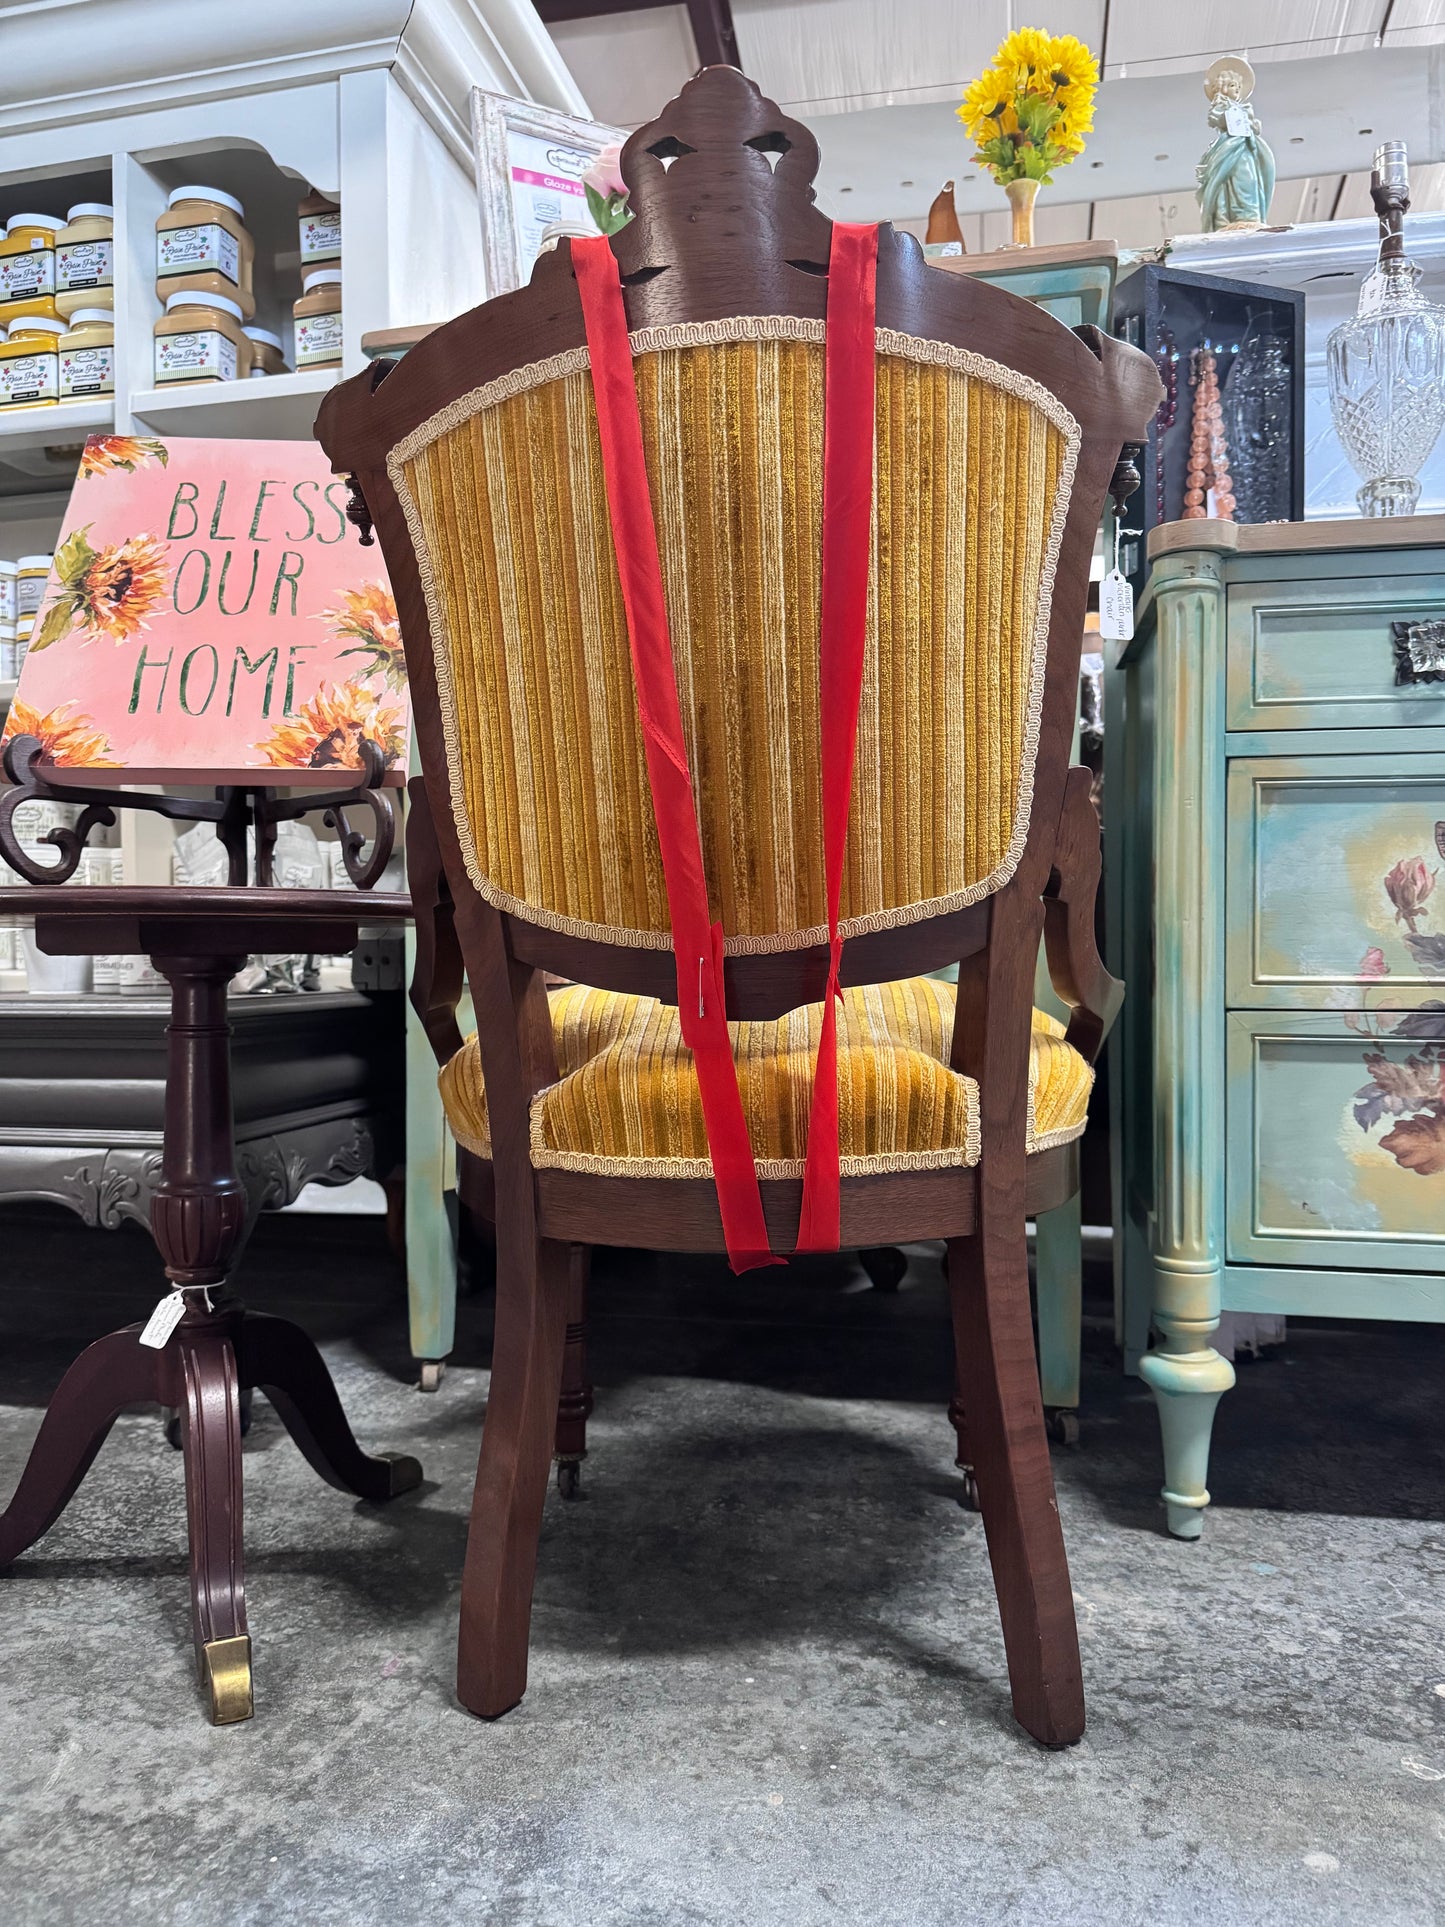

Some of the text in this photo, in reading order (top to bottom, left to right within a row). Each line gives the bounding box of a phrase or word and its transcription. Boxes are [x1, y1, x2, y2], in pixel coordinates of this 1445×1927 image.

[543, 177, 572, 192] Glaze
[166, 479, 346, 545] BLESS
[173, 549, 304, 616] OUR
[128, 644, 318, 719] HOME
